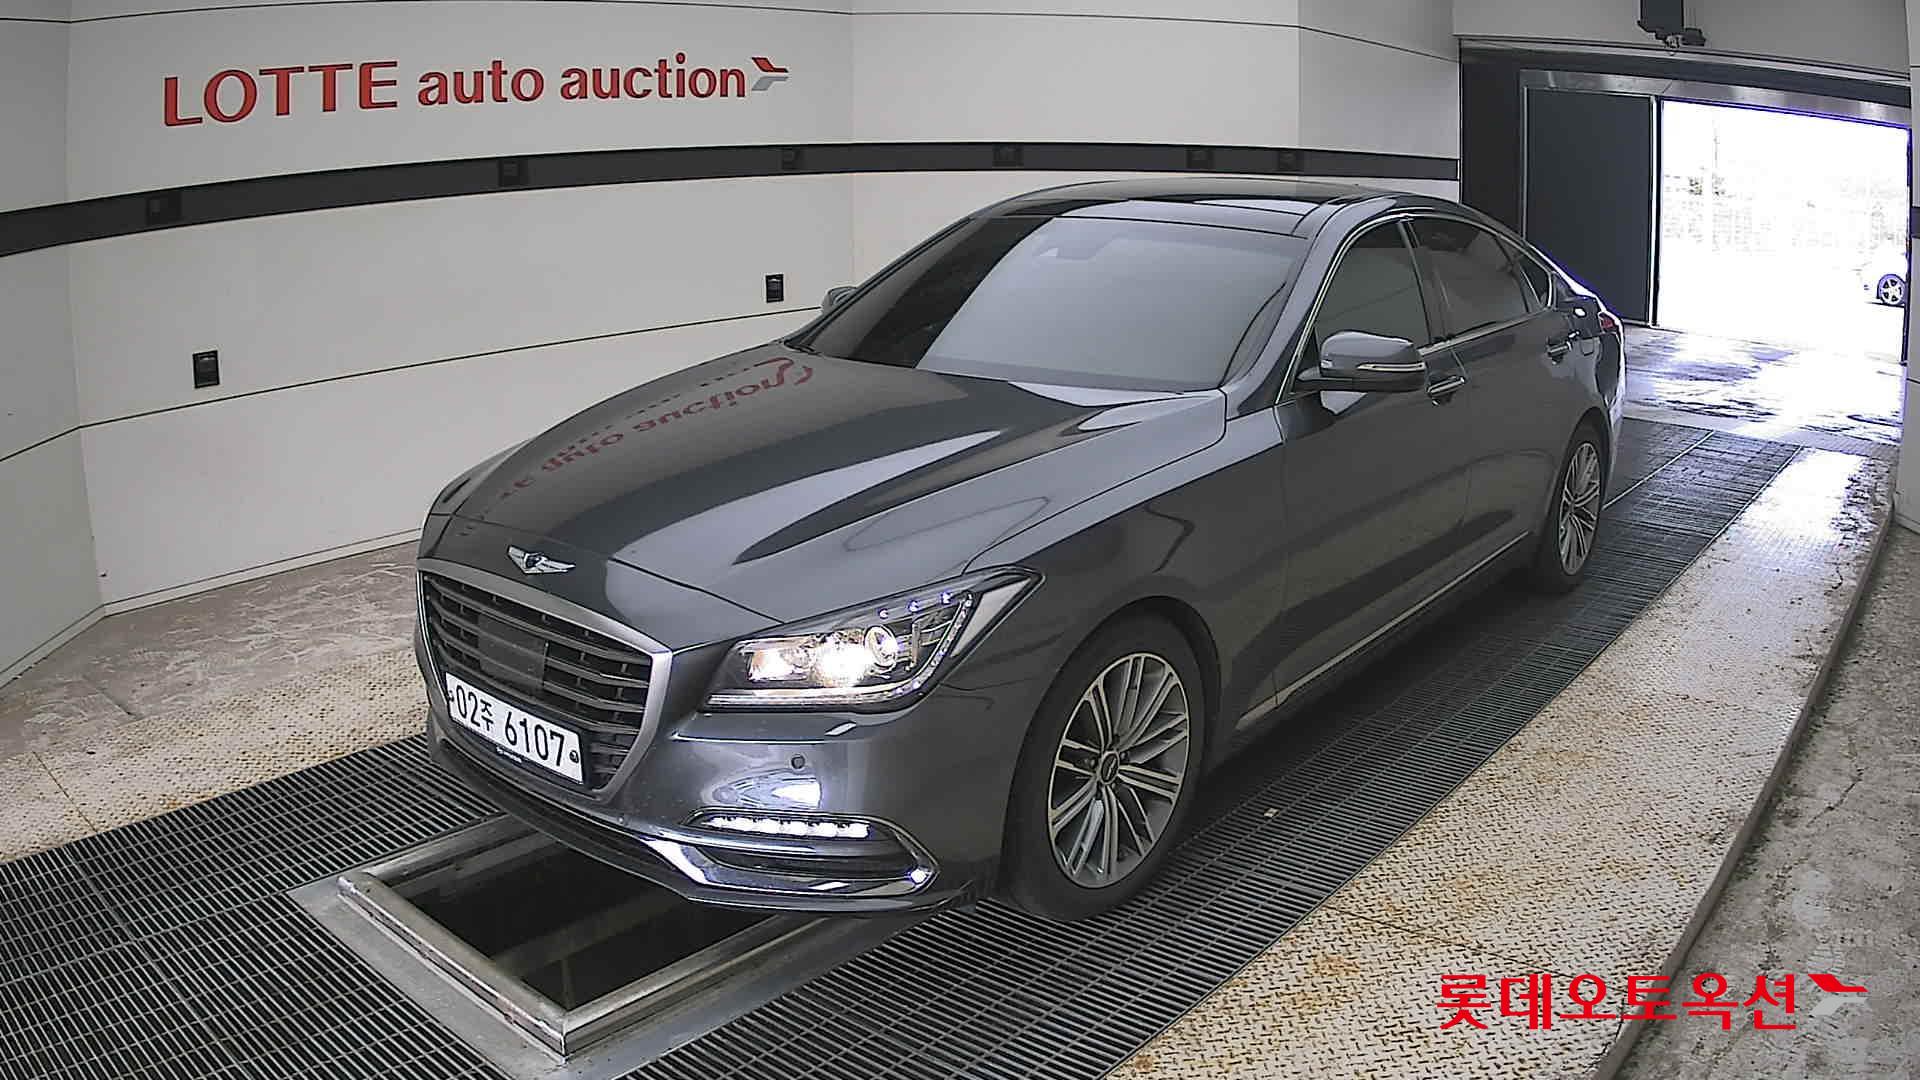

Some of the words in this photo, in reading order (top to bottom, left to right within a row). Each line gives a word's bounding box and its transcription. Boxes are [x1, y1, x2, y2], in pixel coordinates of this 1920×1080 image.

[164, 61, 399, 126] LOTTE
[418, 59, 544, 105] auto
[560, 52, 746, 100] auction
[455, 684, 494, 731] 02주
[504, 711, 565, 767] 6107
